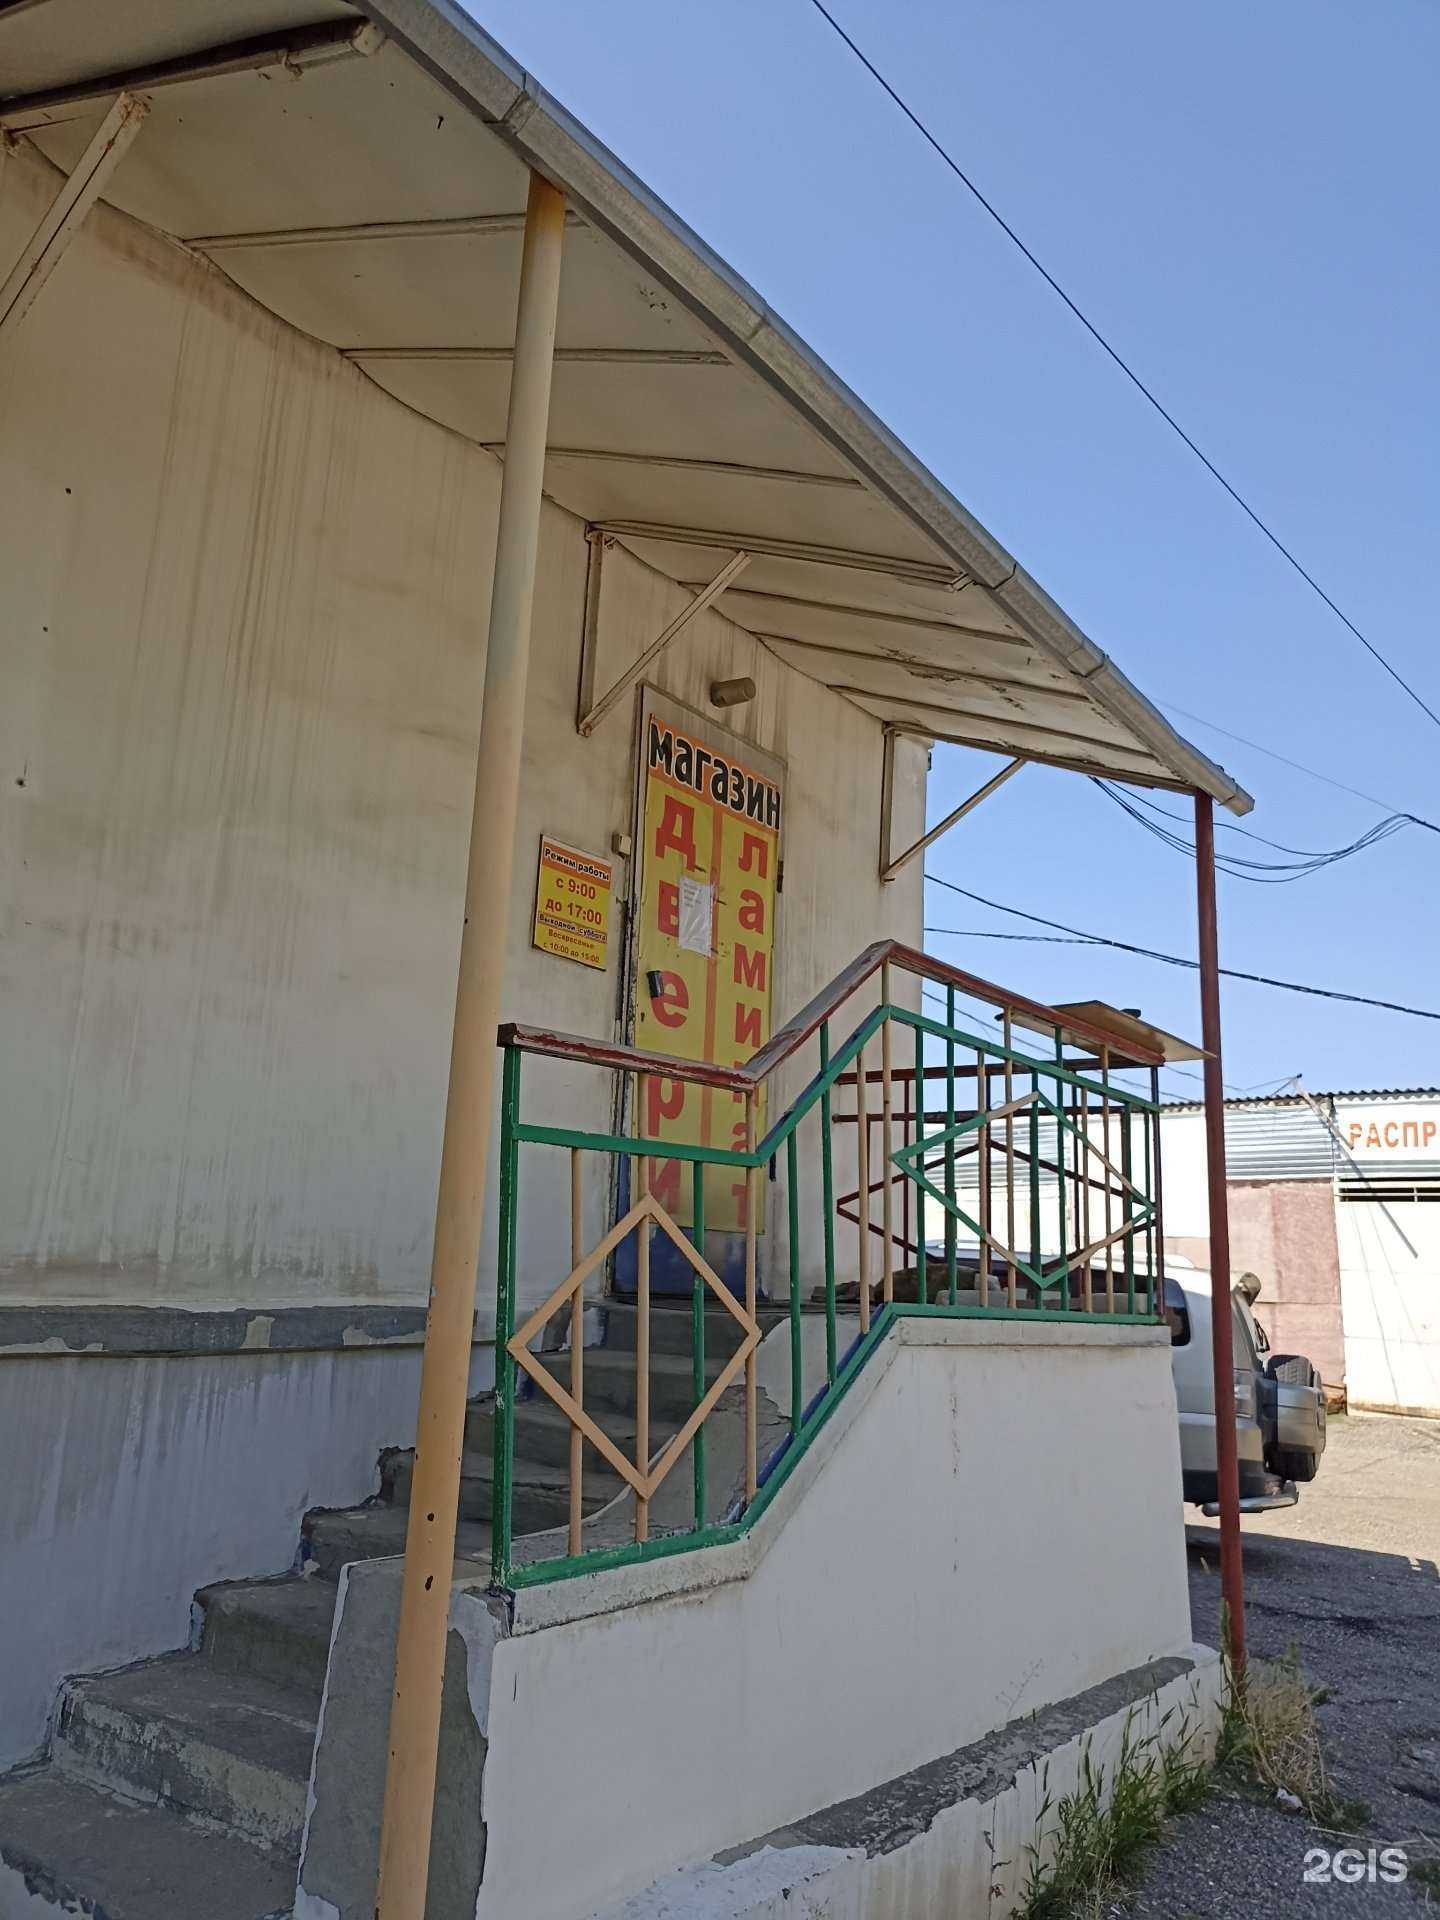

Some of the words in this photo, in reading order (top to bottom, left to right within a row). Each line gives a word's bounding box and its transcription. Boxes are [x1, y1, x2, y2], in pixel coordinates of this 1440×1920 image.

[544, 847, 576, 869] Режим
[577, 864, 609, 880] работы
[555, 878, 564, 888] с
[568, 879, 596, 899] 9:00
[545, 898, 562, 912] до
[567, 901, 602, 925] 17:00
[550, 942, 569, 954] 10:00
